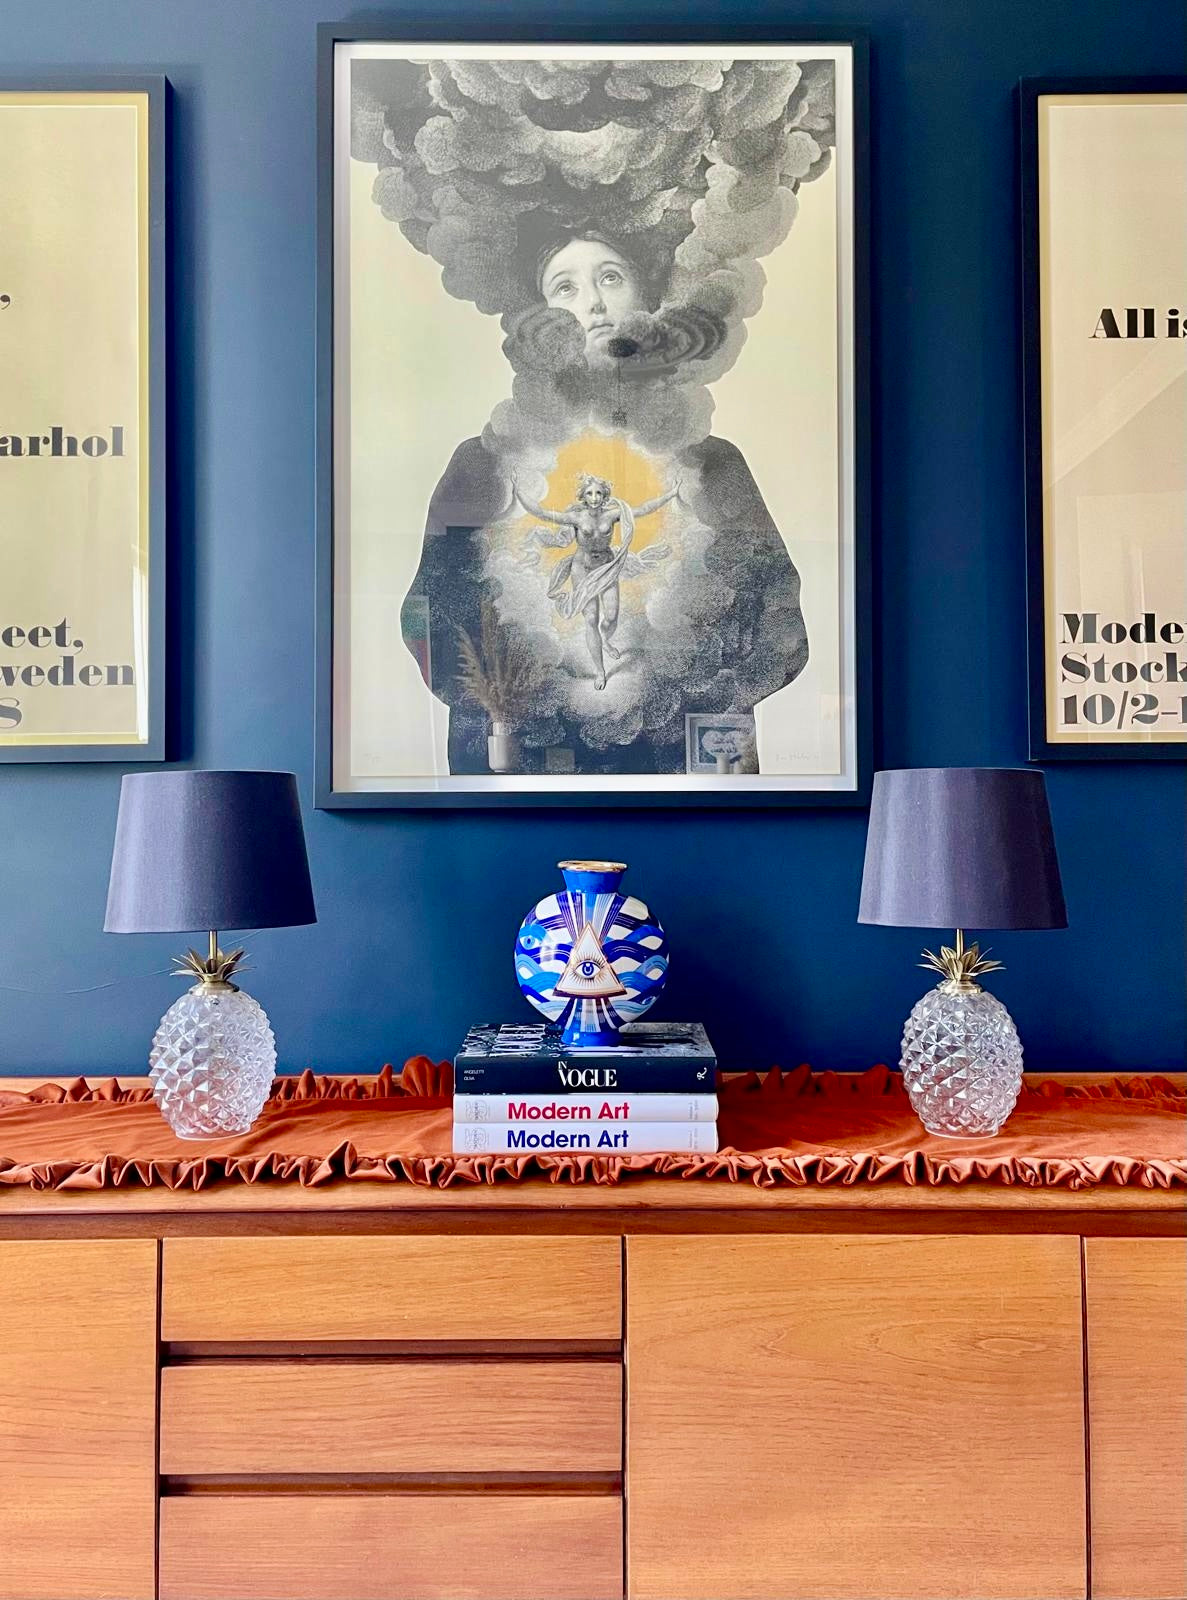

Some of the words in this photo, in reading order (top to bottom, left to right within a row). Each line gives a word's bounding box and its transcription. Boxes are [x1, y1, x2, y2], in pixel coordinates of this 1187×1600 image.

[1088, 308, 1157, 338] All
[1165, 308, 1187, 338] i
[1, 616, 84, 655] eet,
[1059, 612, 1187, 644] Mode
[1061, 651, 1187, 683] Stock
[557, 1060, 568, 1069] IN
[558, 1068, 618, 1087] VOGUE
[508, 1102, 591, 1120] Modern
[597, 1102, 630, 1120] Art
[507, 1130, 590, 1148] Modern
[597, 1130, 629, 1148] Art
